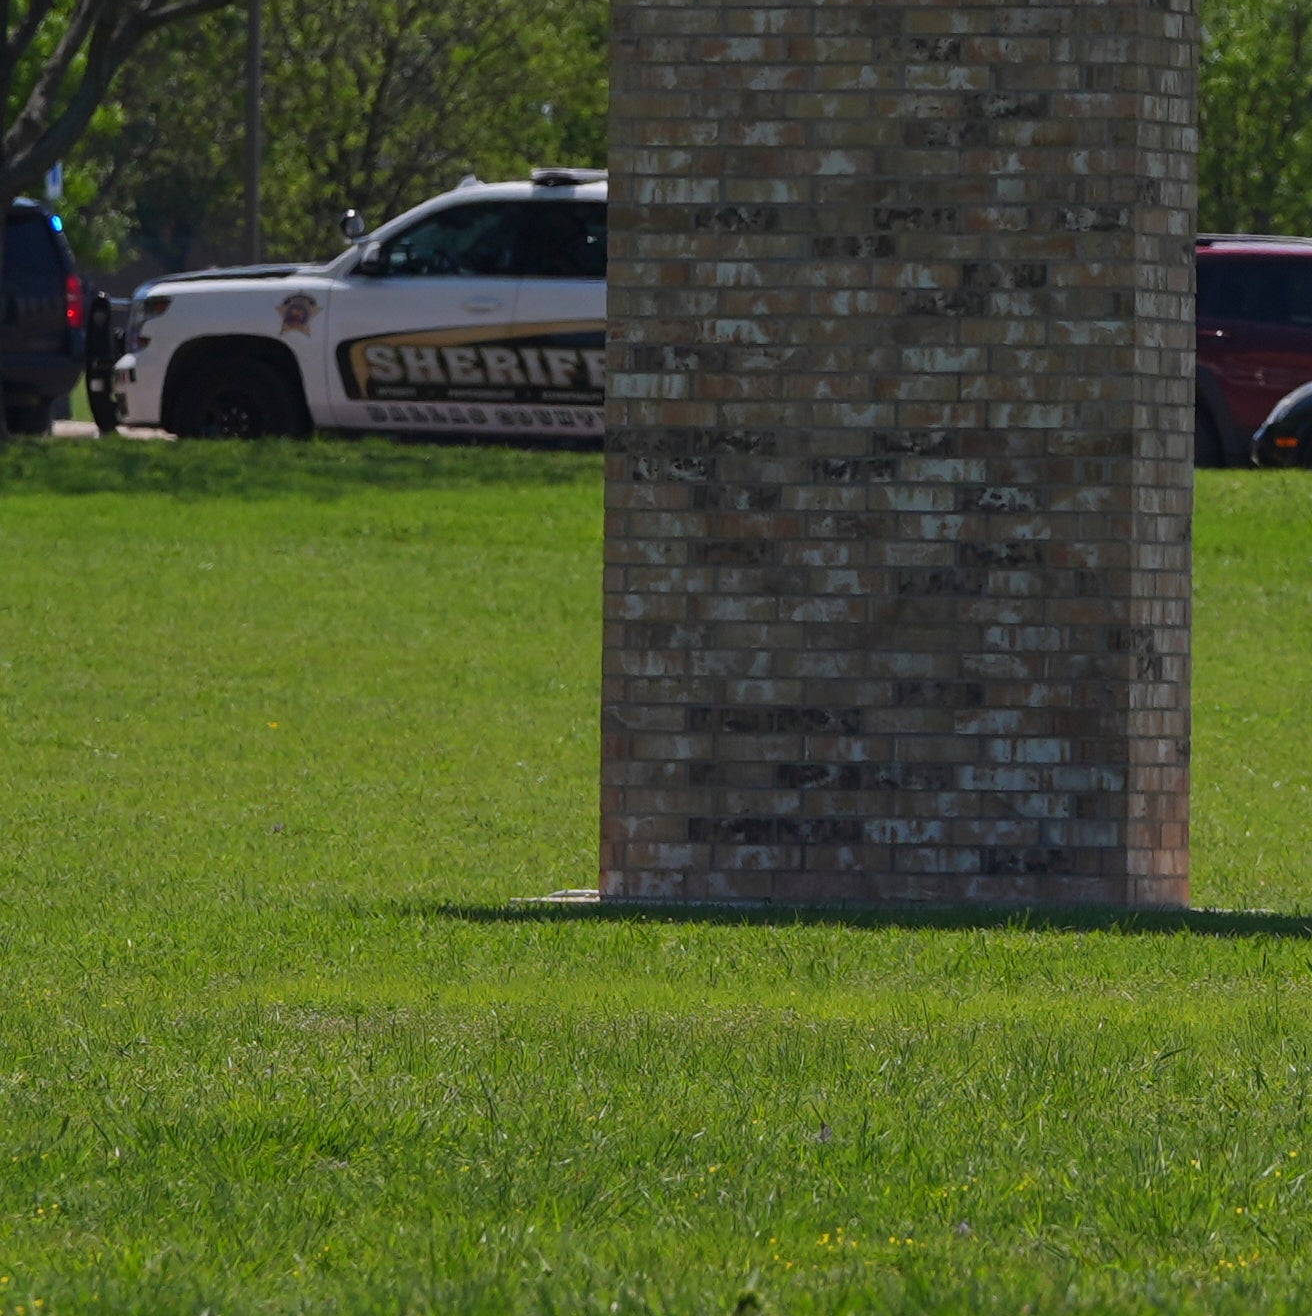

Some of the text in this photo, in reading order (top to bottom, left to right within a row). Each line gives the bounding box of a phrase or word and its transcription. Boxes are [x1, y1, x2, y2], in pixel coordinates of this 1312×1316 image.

[365, 344, 606, 387] SHERIFF
[366, 403, 606, 430] DALLAS COUNT
